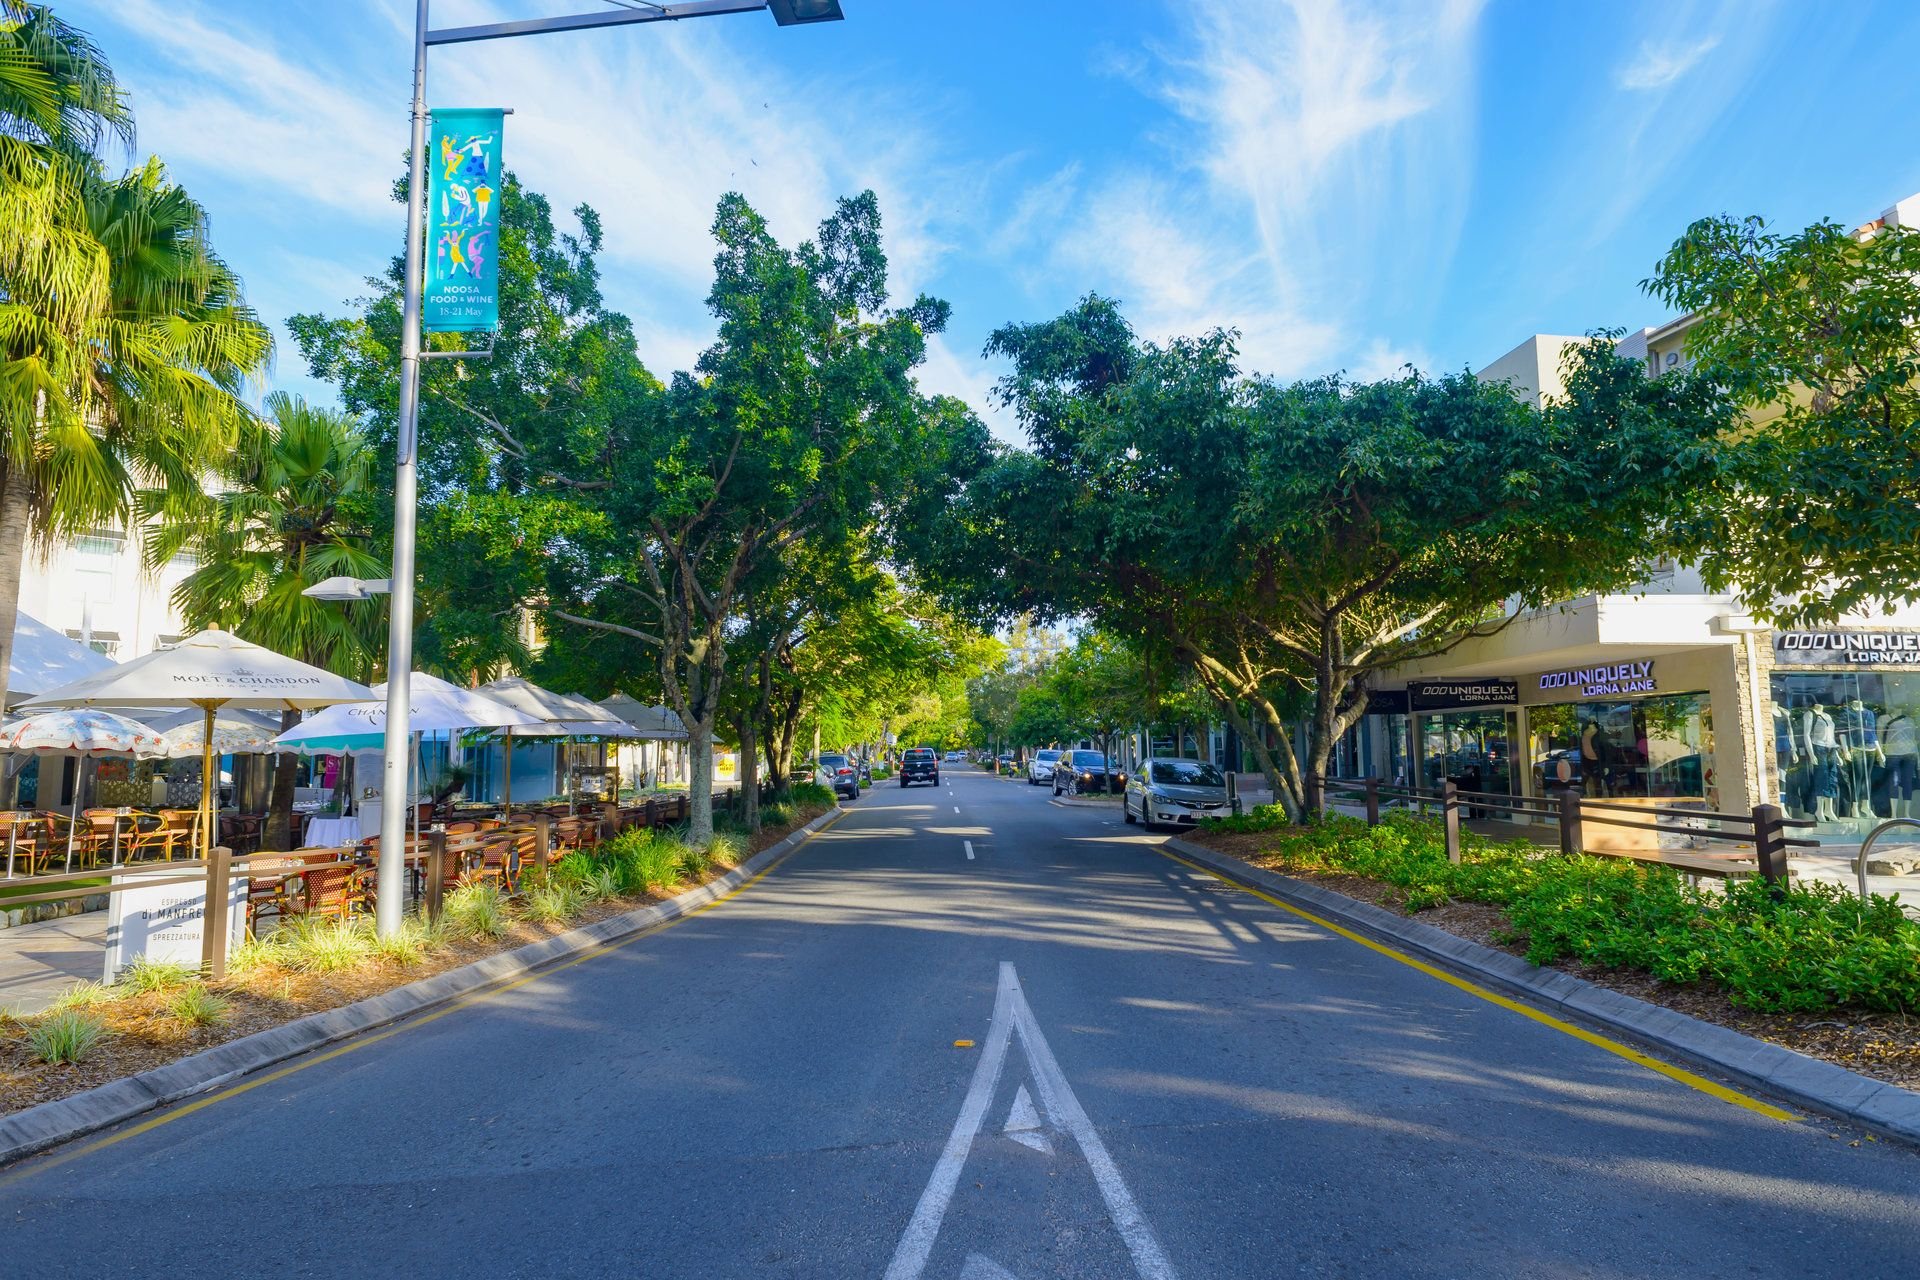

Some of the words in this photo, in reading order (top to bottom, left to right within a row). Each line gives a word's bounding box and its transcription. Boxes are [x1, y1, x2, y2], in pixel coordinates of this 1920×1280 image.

[440, 308, 462, 316] 18-21
[465, 308, 483, 317] May
[1849, 652, 1902, 662] LORNA
[1568, 661, 1652, 686] UNIQUELY
[1450, 686, 1515, 694] UNIQUELY
[1582, 684, 1619, 696] LORNA
[1622, 680, 1655, 692] JANE
[142, 909, 152, 920] di
[158, 908, 207, 918] MANFRE
